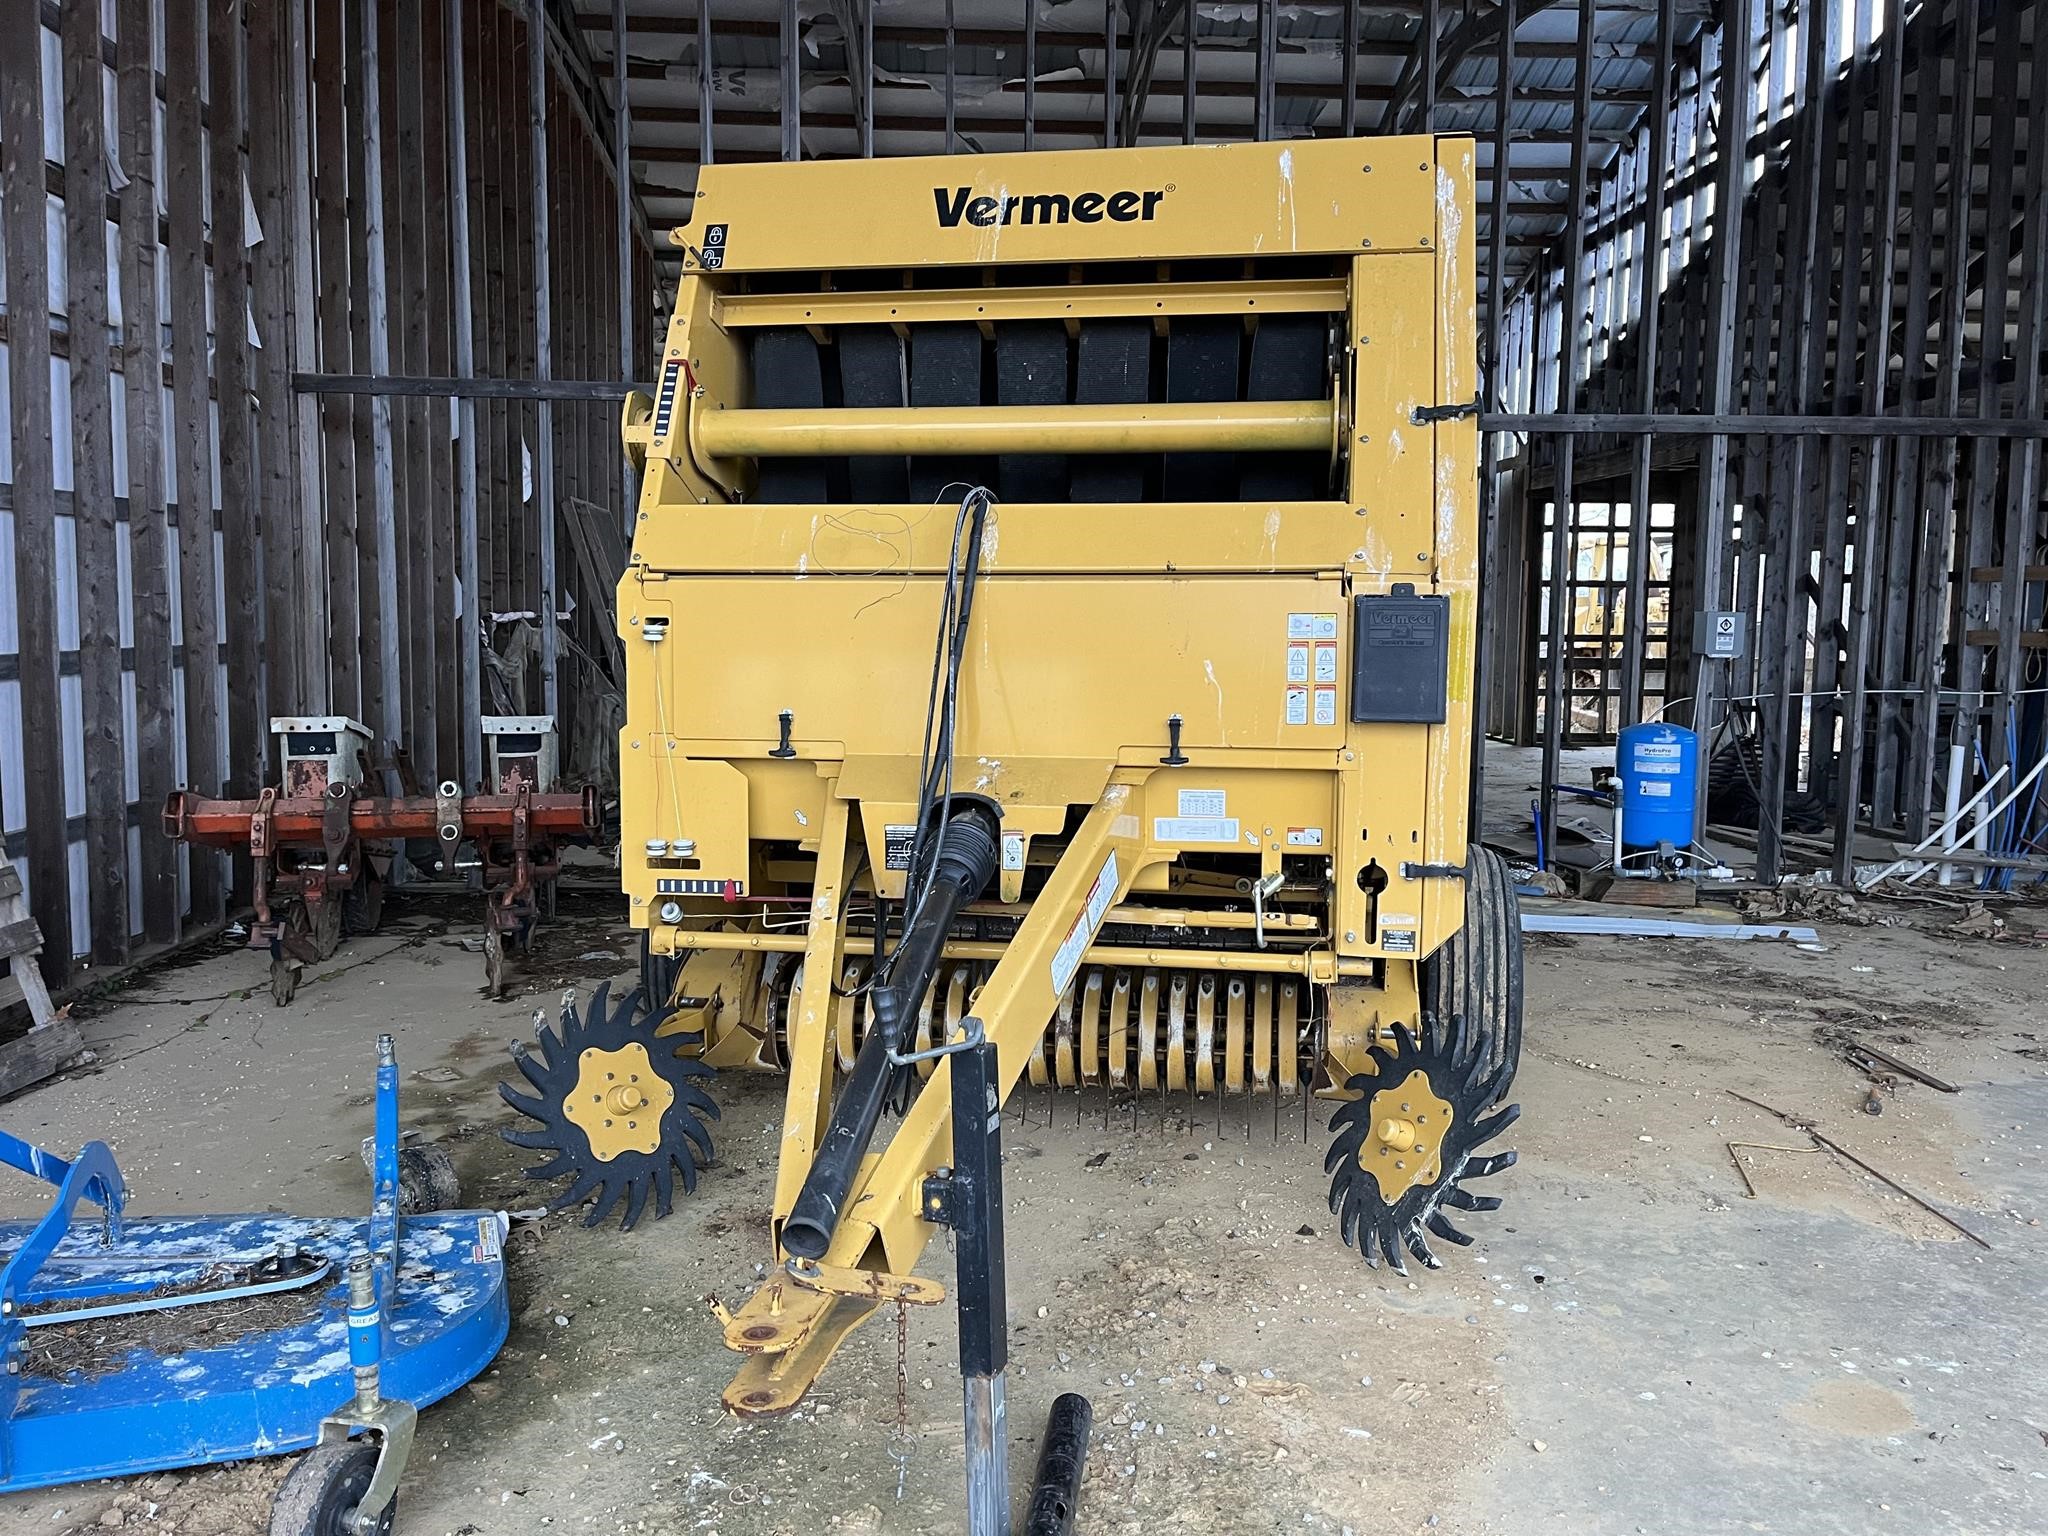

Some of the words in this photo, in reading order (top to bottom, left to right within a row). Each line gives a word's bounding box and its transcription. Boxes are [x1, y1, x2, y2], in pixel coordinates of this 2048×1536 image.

[933, 186, 1164, 228] Vermeer
[1370, 611, 1432, 625] Vermeer
[350, 1314, 379, 1325] GREAS
